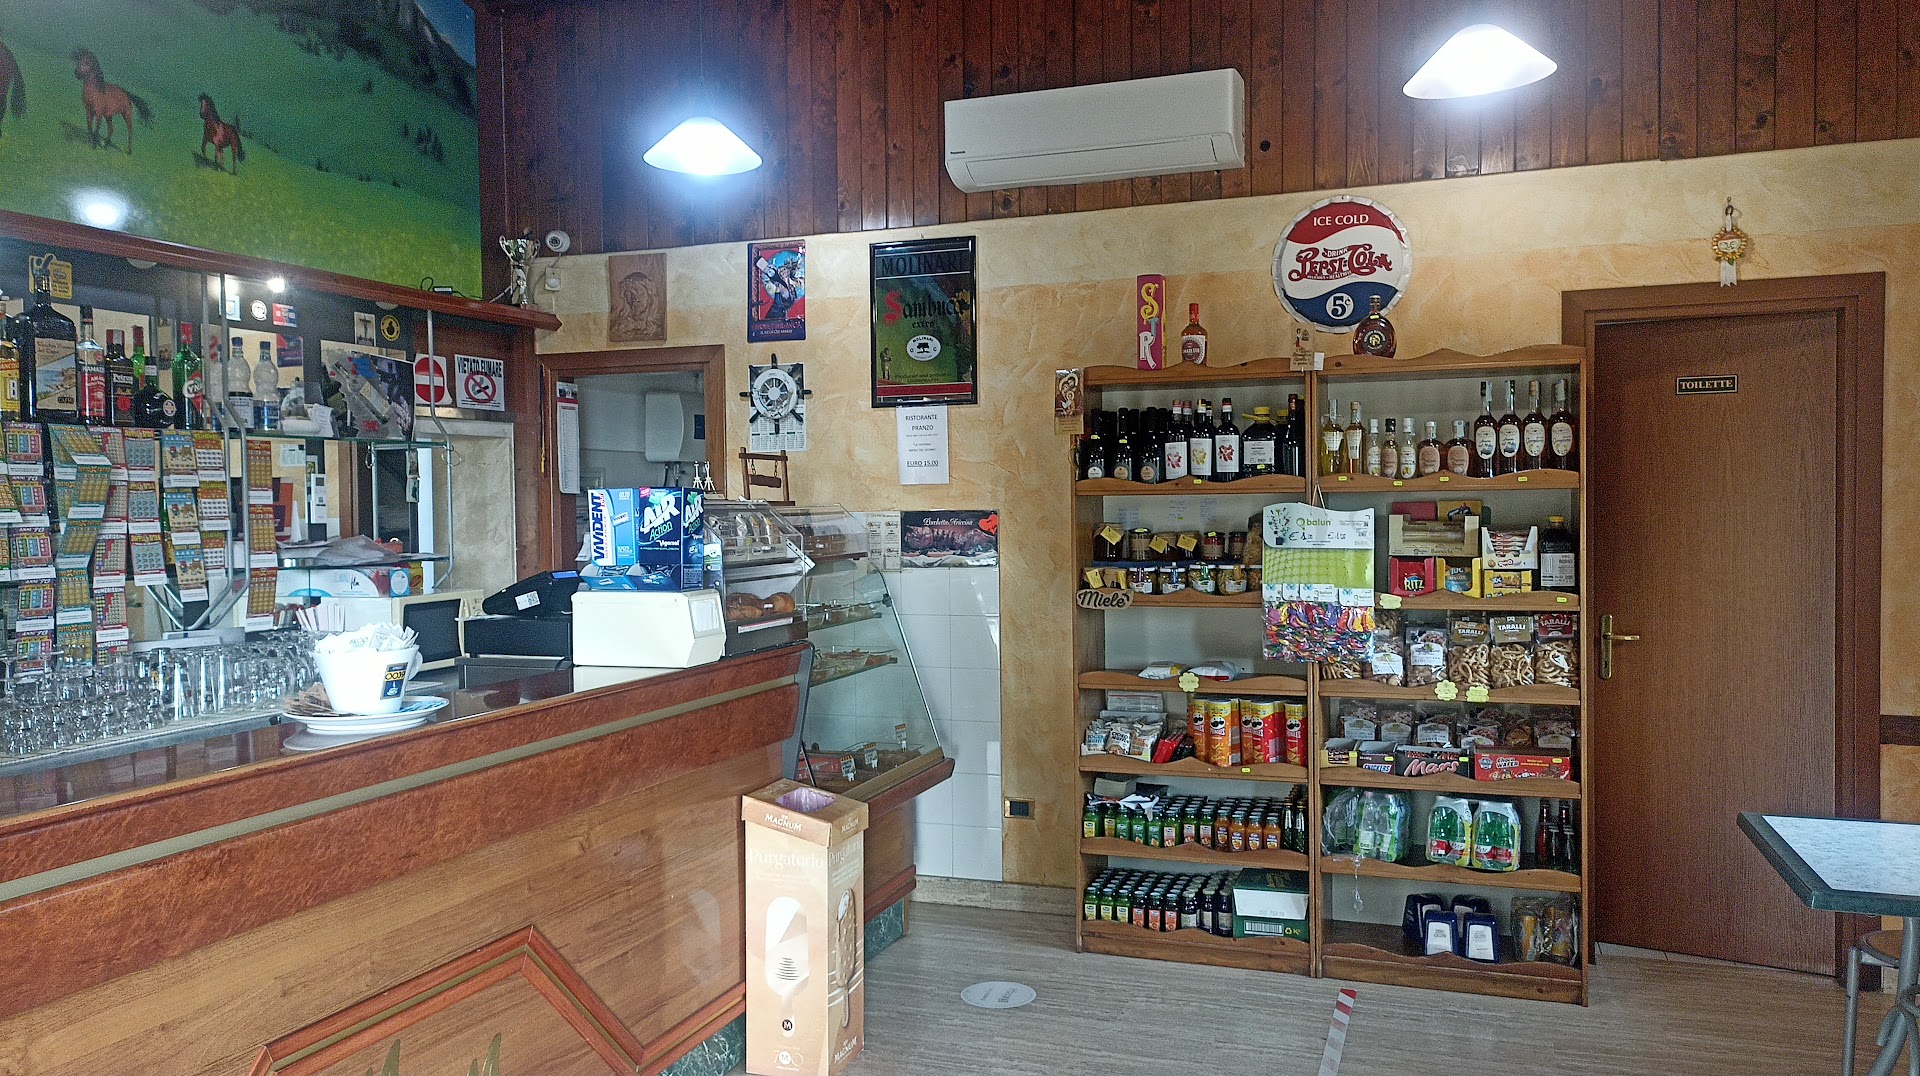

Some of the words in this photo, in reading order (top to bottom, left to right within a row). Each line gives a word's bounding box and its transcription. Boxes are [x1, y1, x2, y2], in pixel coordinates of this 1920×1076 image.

[1313, 216, 1332, 227] ICE
[1335, 214, 1369, 225] COLD
[1327, 247, 1348, 258] DRINK
[881, 253, 966, 276] MOLINARI
[884, 290, 968, 328] Sambuca
[456, 356, 479, 374] VIETATO
[480, 359, 502, 378] FUMARE
[1680, 379, 1733, 390] TOILETTE
[640, 493, 681, 535] AIR
[683, 494, 704, 529] AIR
[590, 492, 605, 561] VIVIDENT
[650, 521, 673, 541] Action
[688, 518, 701, 534] Action
[1404, 578, 1425, 590] RITZ
[1078, 591, 1127, 608] Miele
[1364, 764, 1390, 772] SNICKERS
[1404, 758, 1460, 777] Mars
[765, 813, 802, 832] MAGNUM
[748, 848, 824, 869] Purgatorio
[783, 1021, 792, 1030] M
